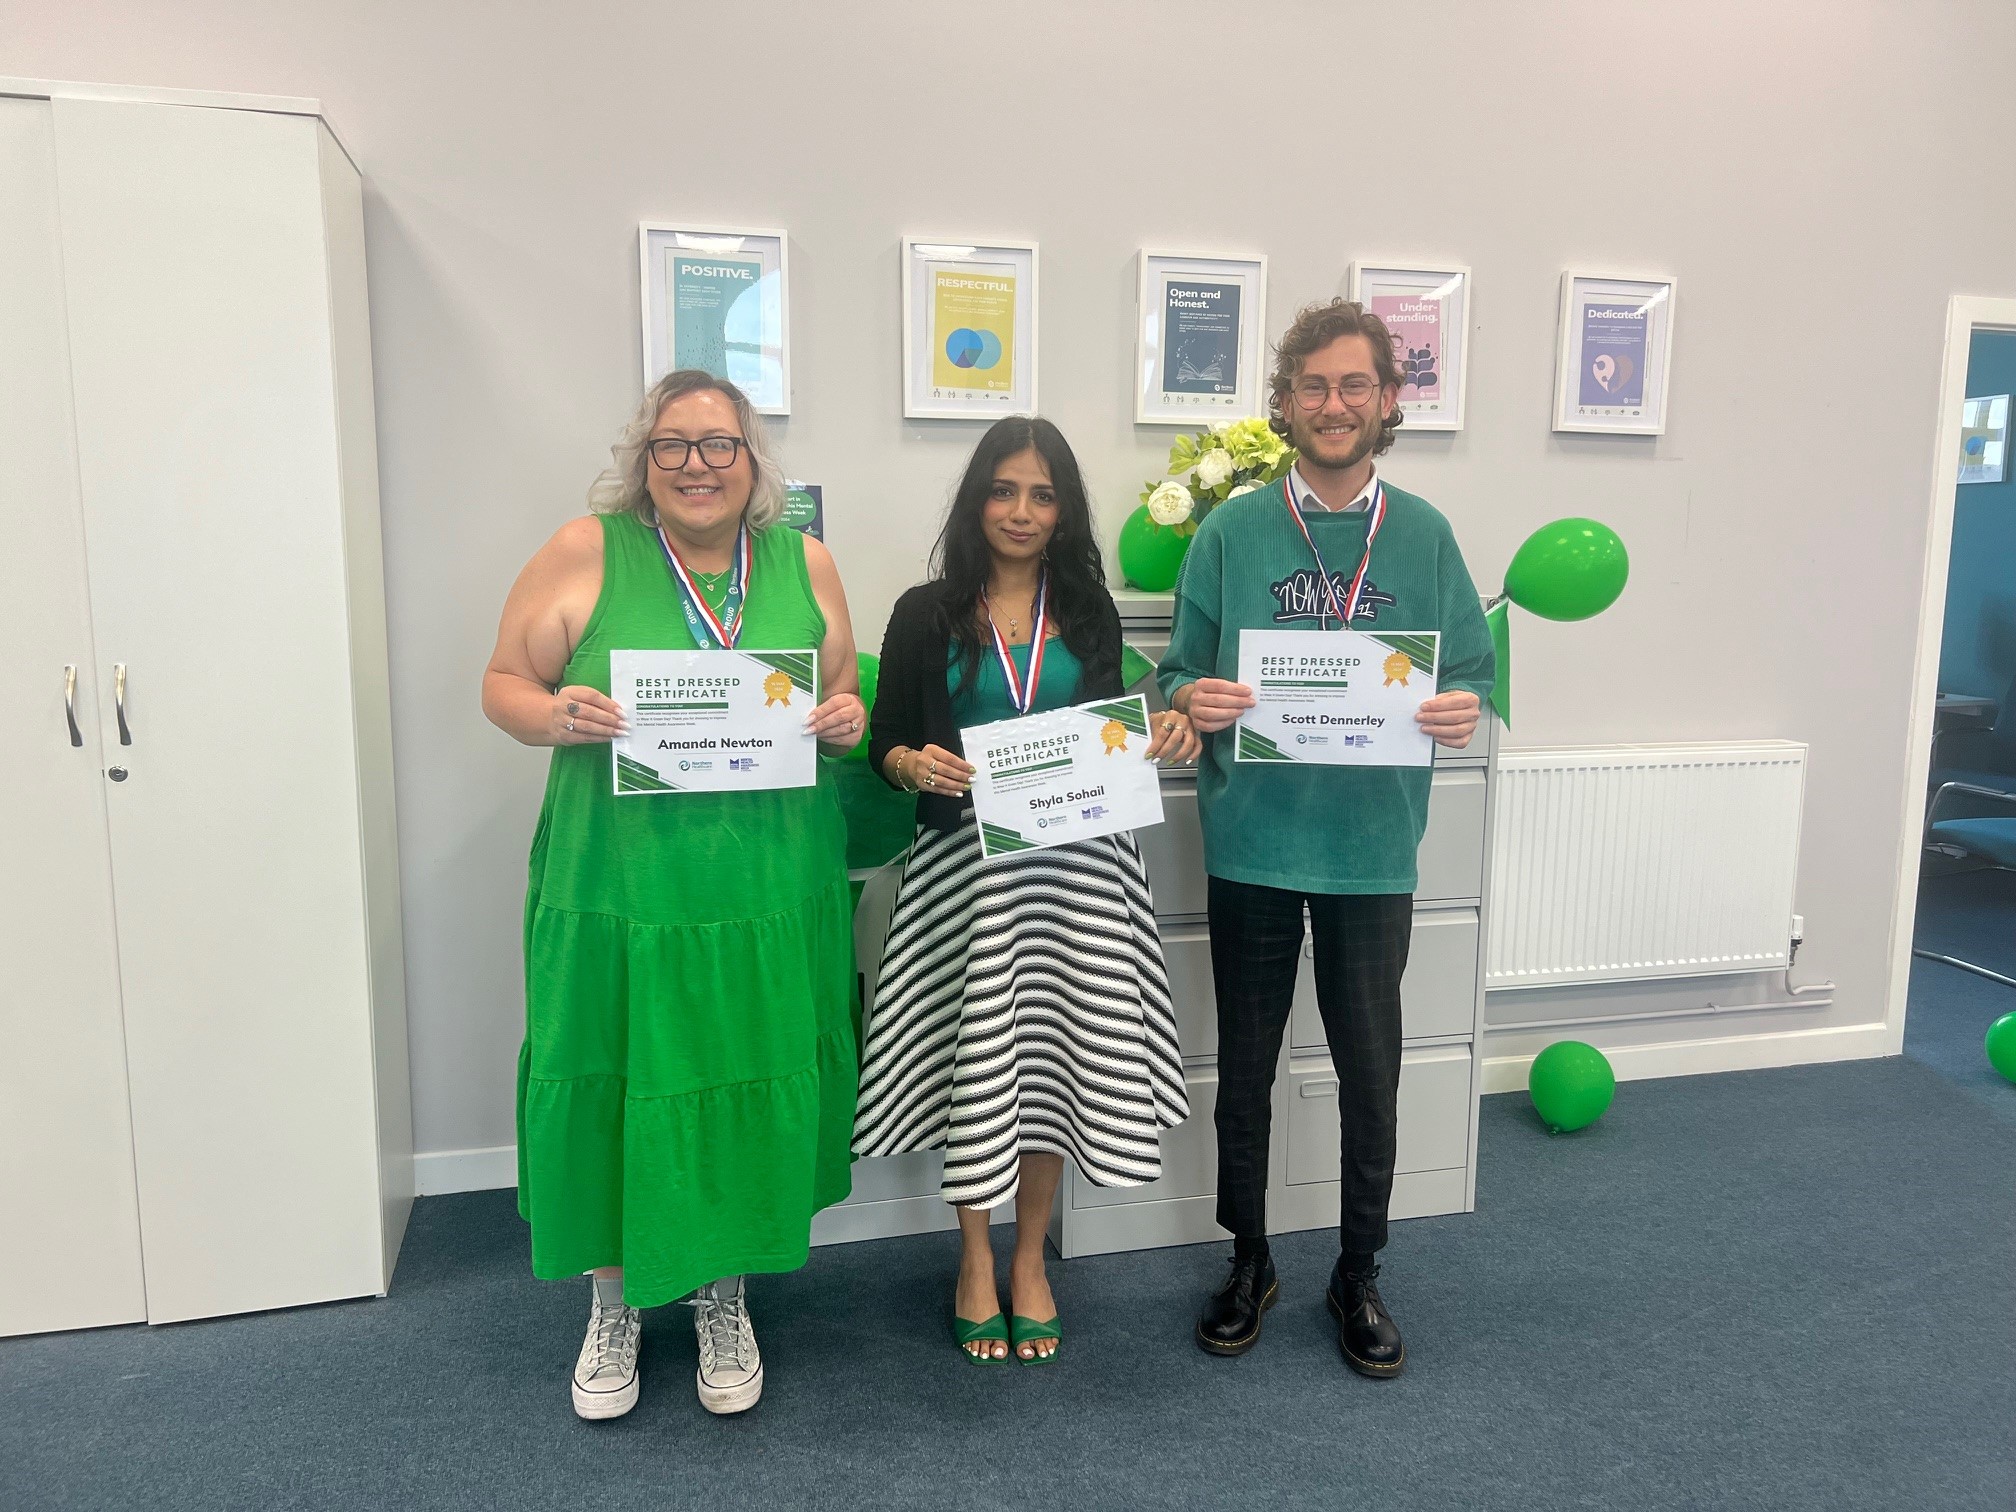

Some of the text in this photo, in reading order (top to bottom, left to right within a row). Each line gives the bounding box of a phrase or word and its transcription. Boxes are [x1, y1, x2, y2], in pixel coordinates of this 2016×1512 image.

[682, 264, 753, 280] POSITIVE.
[937, 278, 1014, 292] RESPECTFUL.
[1170, 288, 1220, 299] Open and
[1170, 298, 1210, 308] Honest.
[1400, 301, 1438, 312] Under-
[1386, 312, 1438, 324] standing.
[1588, 310, 1643, 320] Dedicated.
[682, 600, 697, 624] PROUD
[724, 607, 734, 631] PROUD
[1262, 657, 1360, 666] BEST DRESSED
[1261, 668, 1346, 676] CERTIFICATE
[636, 678, 740, 687] BEST DRESSED
[636, 690, 726, 698] CERTIFICATE
[1282, 714, 1385, 728] Scott Dennerley
[658, 738, 772, 750] Amanda Newton
[987, 734, 1080, 758] BEST DRESSED
[989, 746, 1069, 769] CERTIFICATE
[1029, 785, 1105, 809] Shyla Sohail
